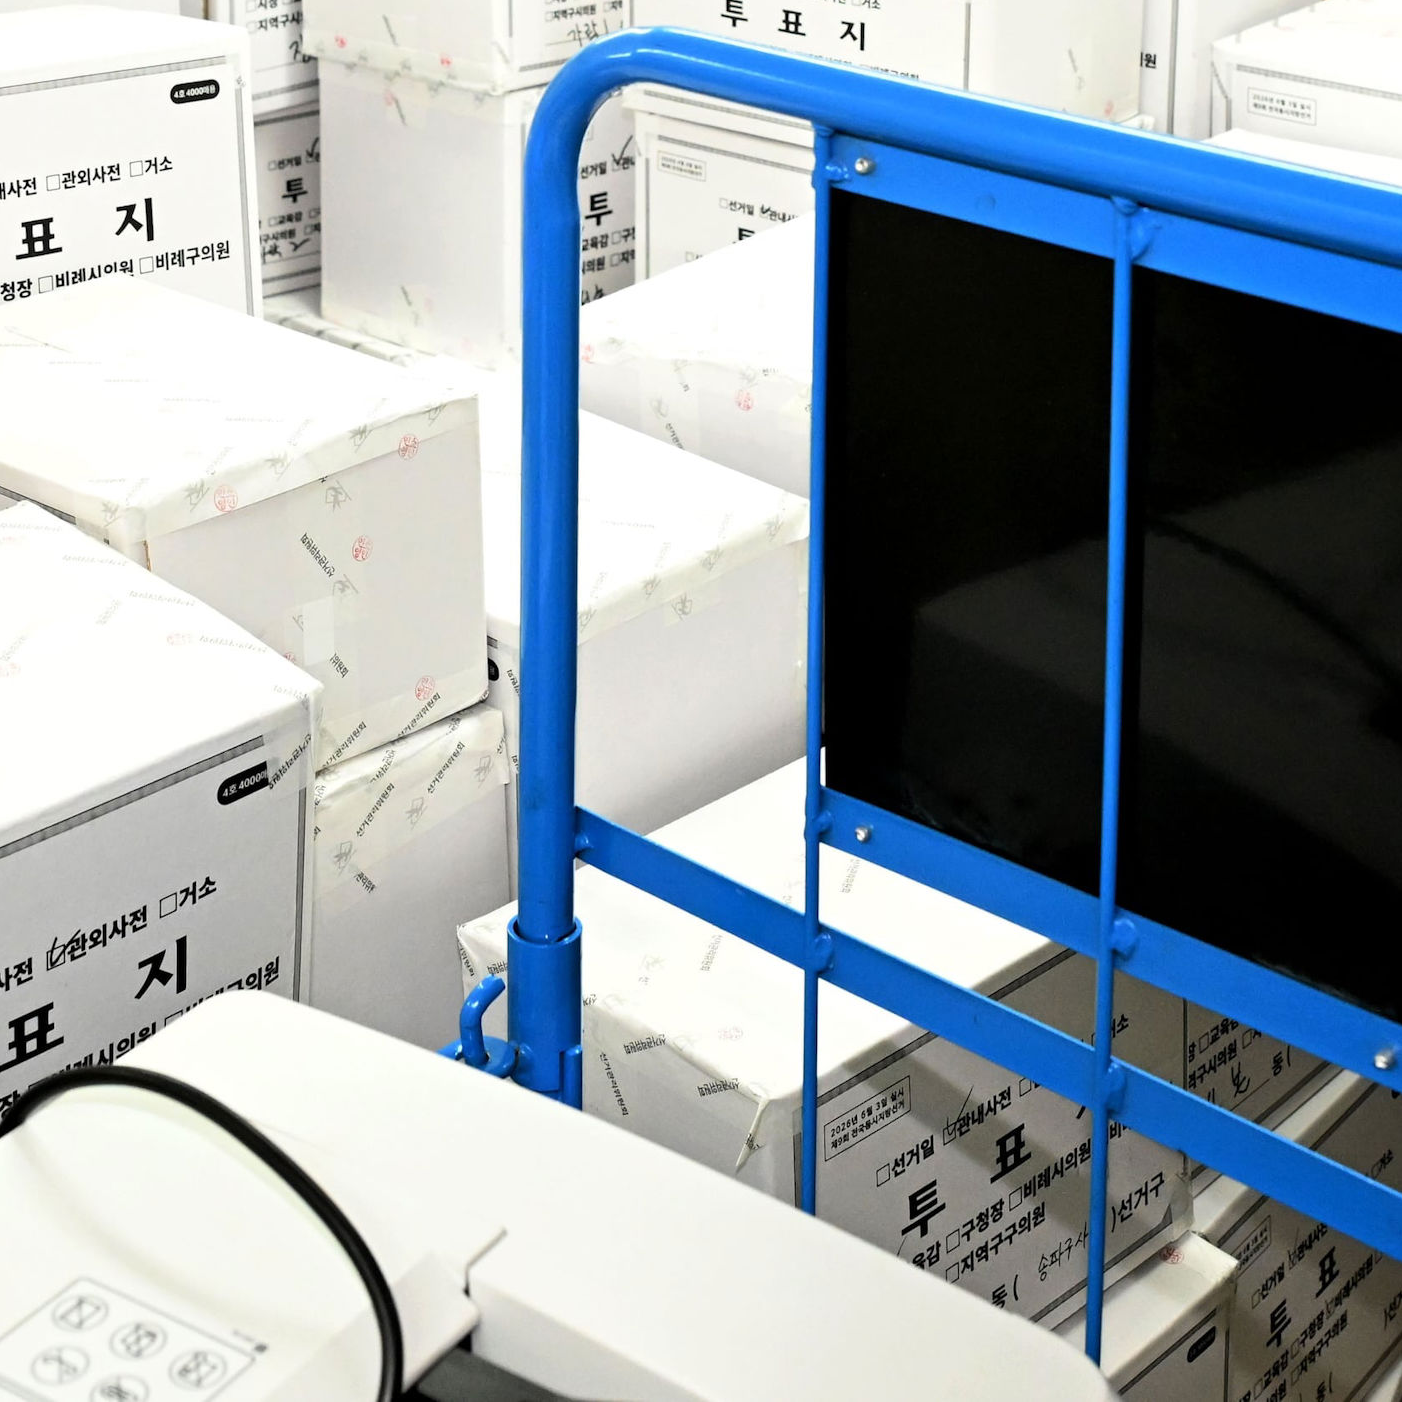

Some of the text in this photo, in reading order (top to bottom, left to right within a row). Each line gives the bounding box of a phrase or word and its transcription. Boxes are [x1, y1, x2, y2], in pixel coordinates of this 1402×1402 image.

[61, 163, 121, 189] 관외사전
[144, 156, 173, 175] 거소
[155, 240, 230, 271] 비례구의원
[68, 905, 148, 962] 관외사전
[179, 877, 217, 908] 거소
[892, 1086, 1012, 1177] 선거일 관내사전
[961, 1139, 1091, 1242] 구청장 비례시의원
[961, 1202, 1045, 1273] 지역구구의원
